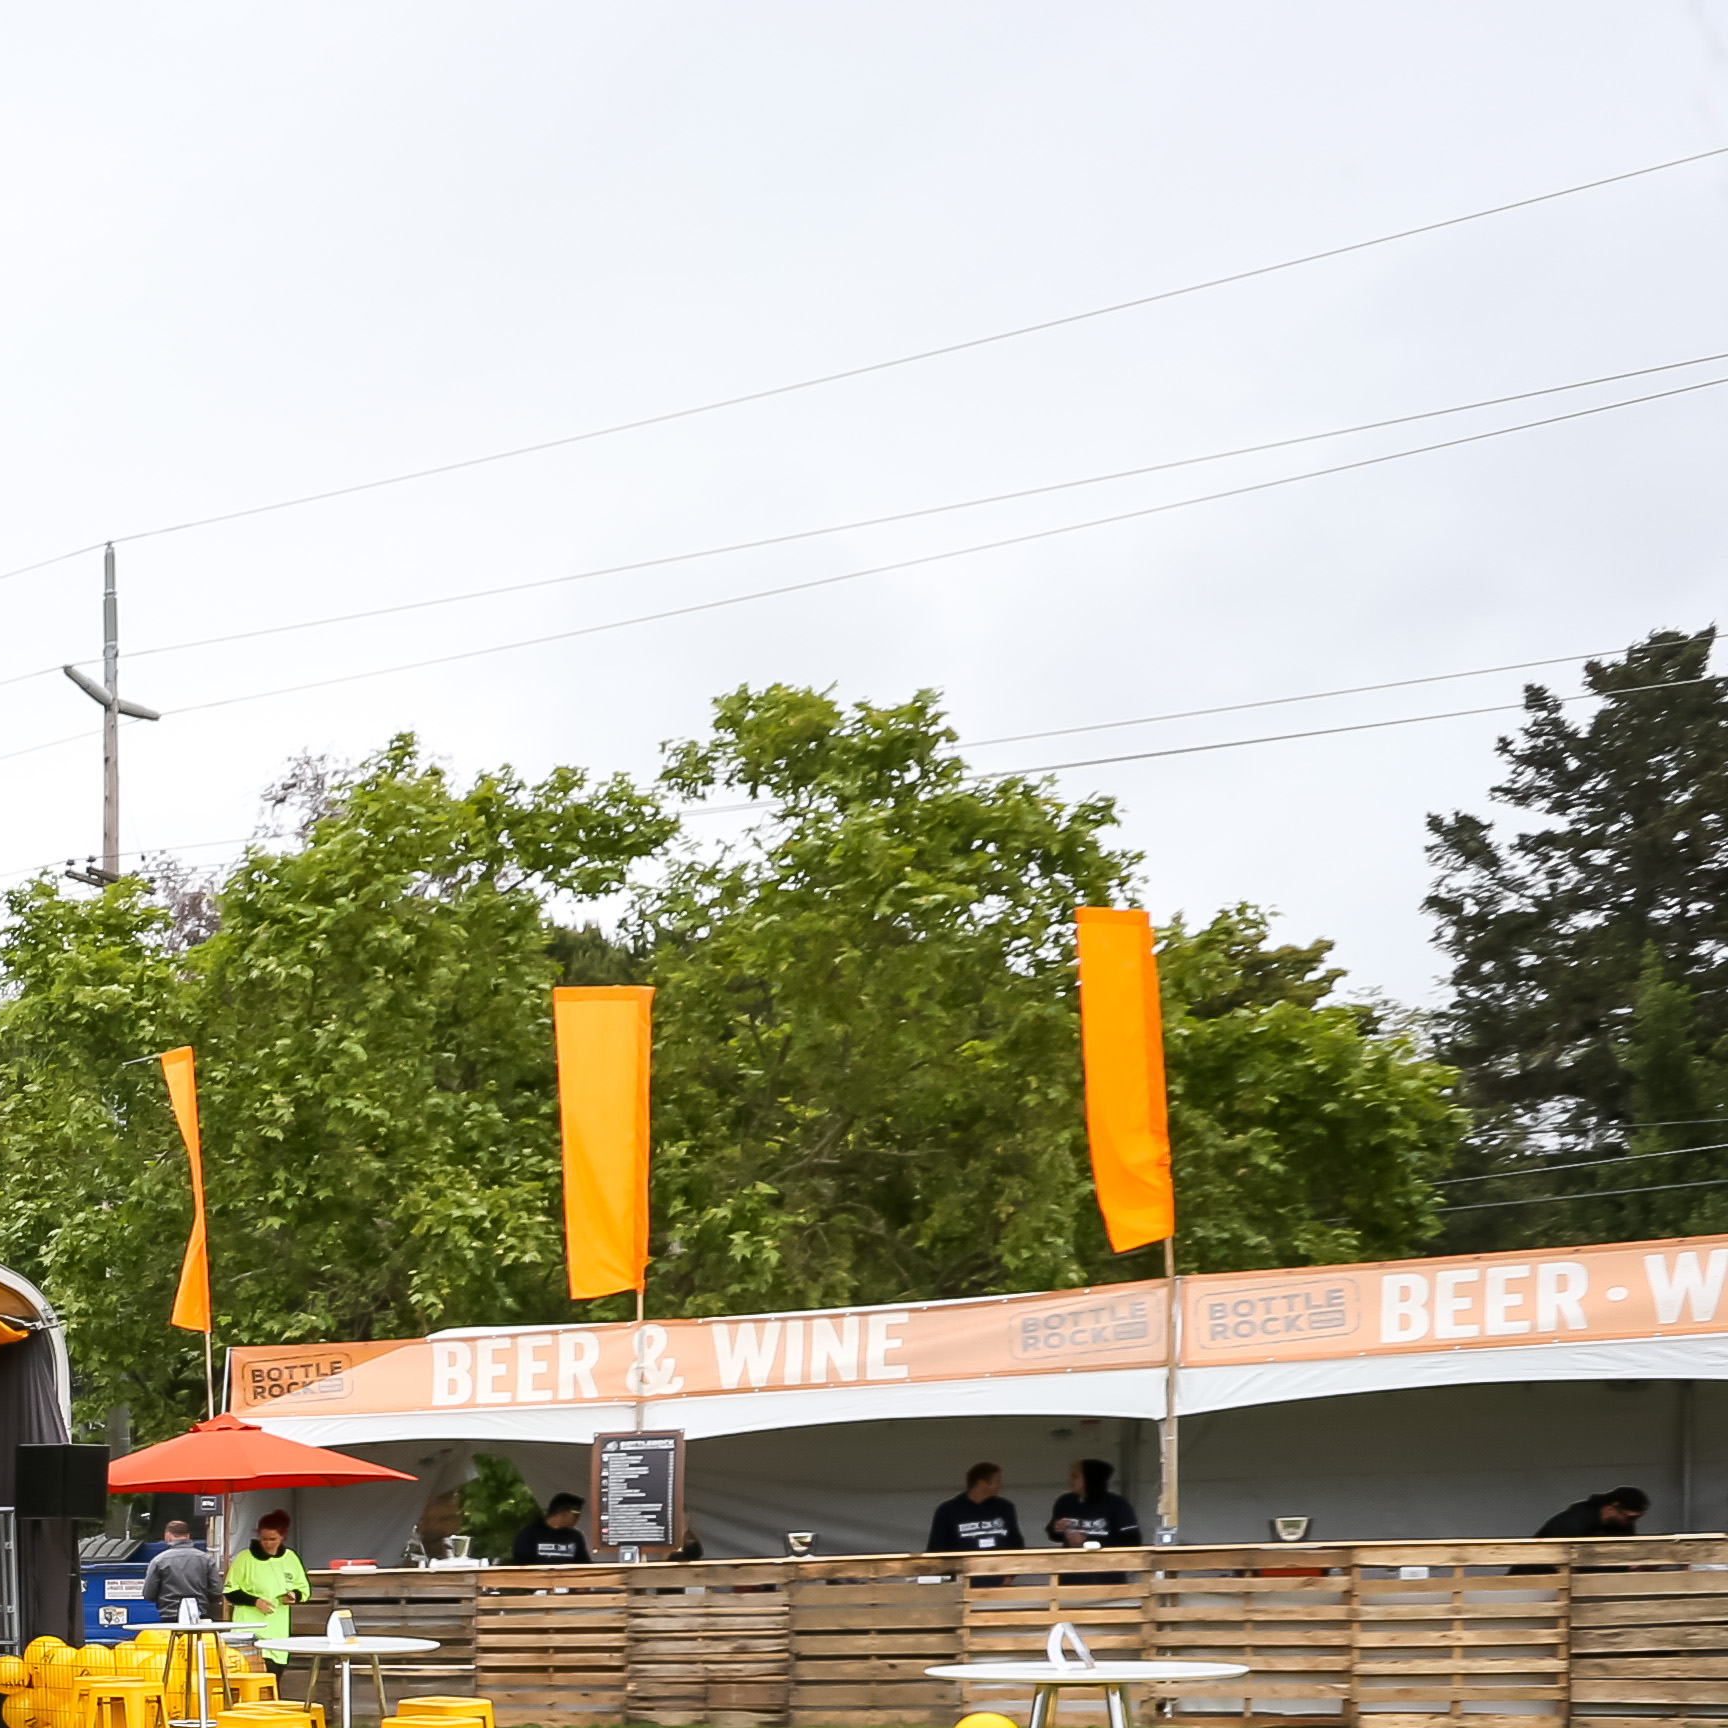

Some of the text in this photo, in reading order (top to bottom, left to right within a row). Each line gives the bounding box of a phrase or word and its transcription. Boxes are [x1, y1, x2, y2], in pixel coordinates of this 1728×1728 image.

[1209, 1288, 1345, 1321] BOTTLE
[1380, 1261, 1588, 1343] BEER
[1021, 1301, 1146, 1334] BOTTLE
[1211, 1314, 1304, 1341] ROCK
[1022, 1325, 1112, 1351] ROCK
[251, 1361, 342, 1383] BOTTLE
[432, 1313, 909, 1406] BEER & WINE
[253, 1380, 317, 1400] ROCK
